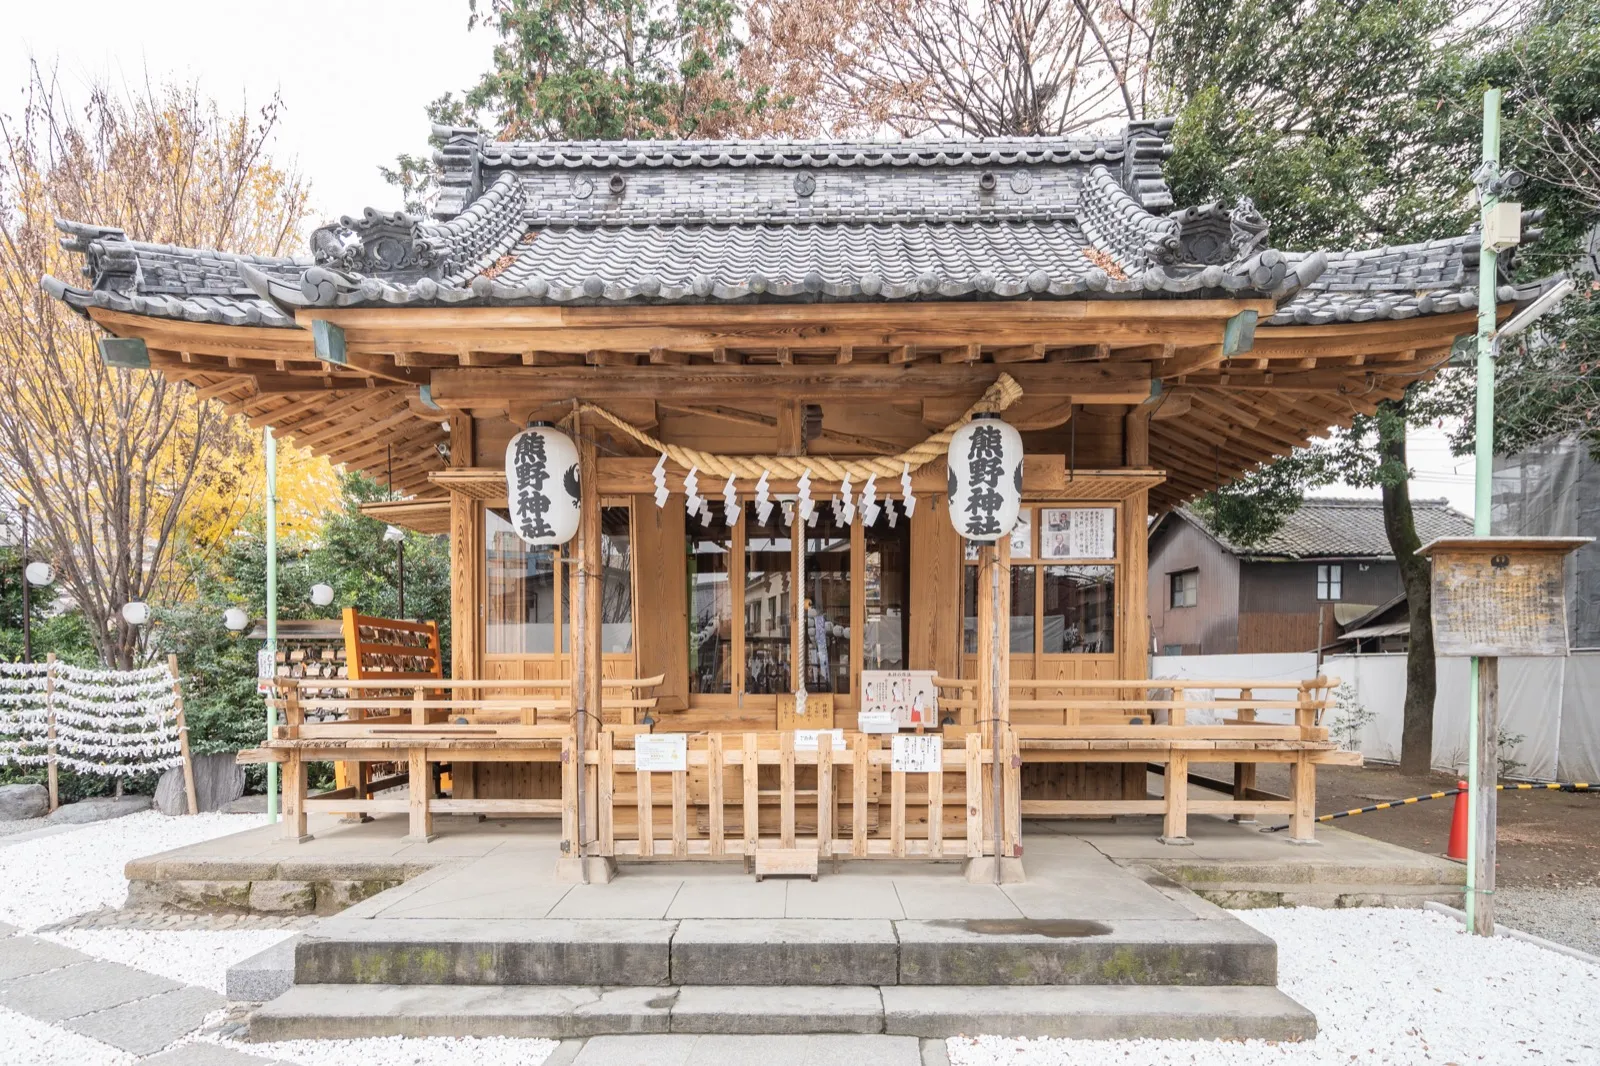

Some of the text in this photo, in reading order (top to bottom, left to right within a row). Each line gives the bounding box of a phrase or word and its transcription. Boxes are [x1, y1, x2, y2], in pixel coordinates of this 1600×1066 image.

[514, 432, 556, 539] 熊野神社
[965, 426, 1004, 534] 熊野神社
